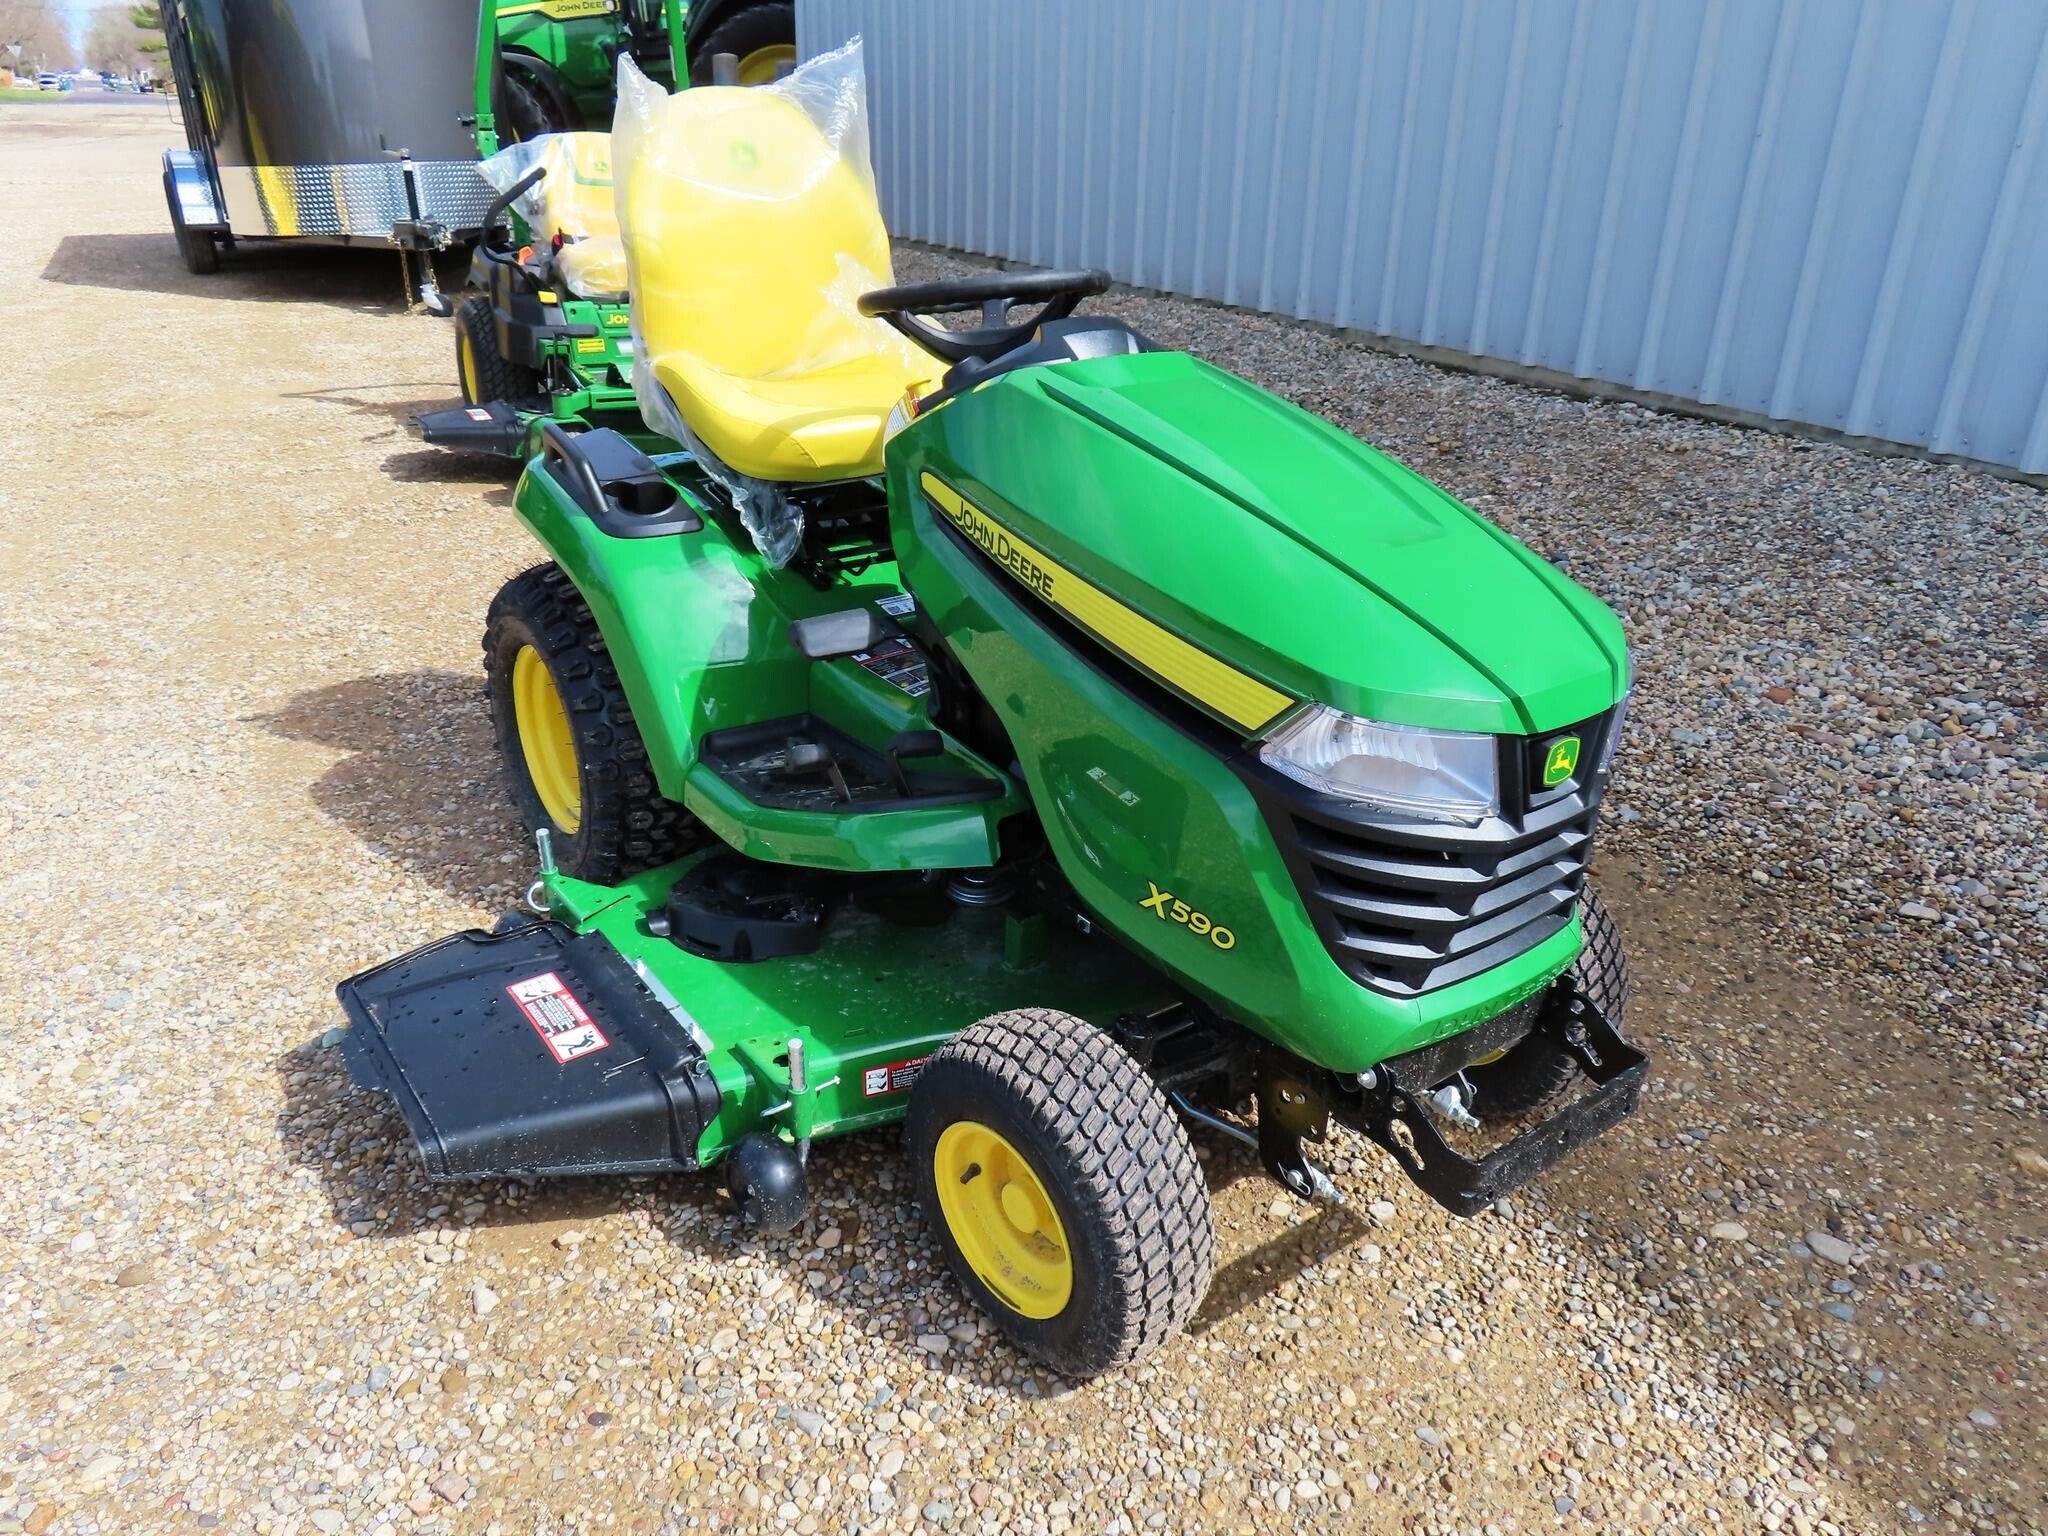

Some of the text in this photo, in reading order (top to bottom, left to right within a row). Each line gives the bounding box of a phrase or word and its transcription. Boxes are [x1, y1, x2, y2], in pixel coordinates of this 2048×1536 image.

[555, 1, 608, 12] JOHN DEER
[955, 500, 1054, 599] JOHN DEERE
[1138, 880, 1236, 950] X590
